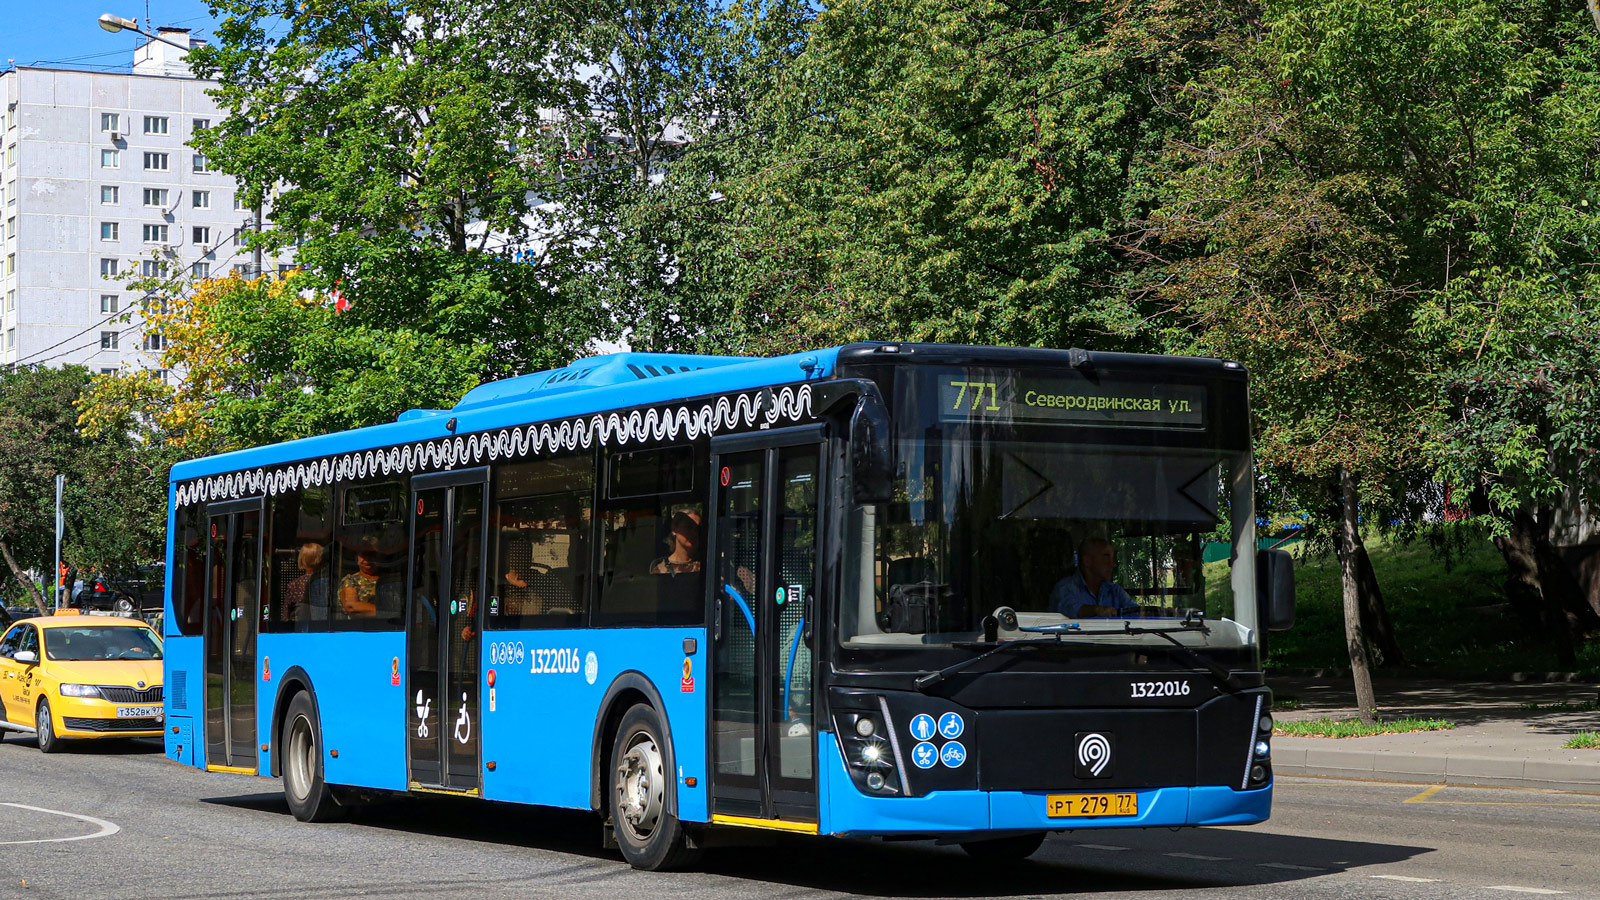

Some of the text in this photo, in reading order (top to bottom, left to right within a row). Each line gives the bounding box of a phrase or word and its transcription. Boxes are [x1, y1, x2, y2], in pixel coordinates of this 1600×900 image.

[950, 381, 1000, 411] 771
[1025, 391, 1192, 414] Северодвинская ул.
[530, 648, 580, 674] 1322016
[1130, 680, 1191, 698] 1322016
[1055, 795, 1132, 814] РТ 279 77
